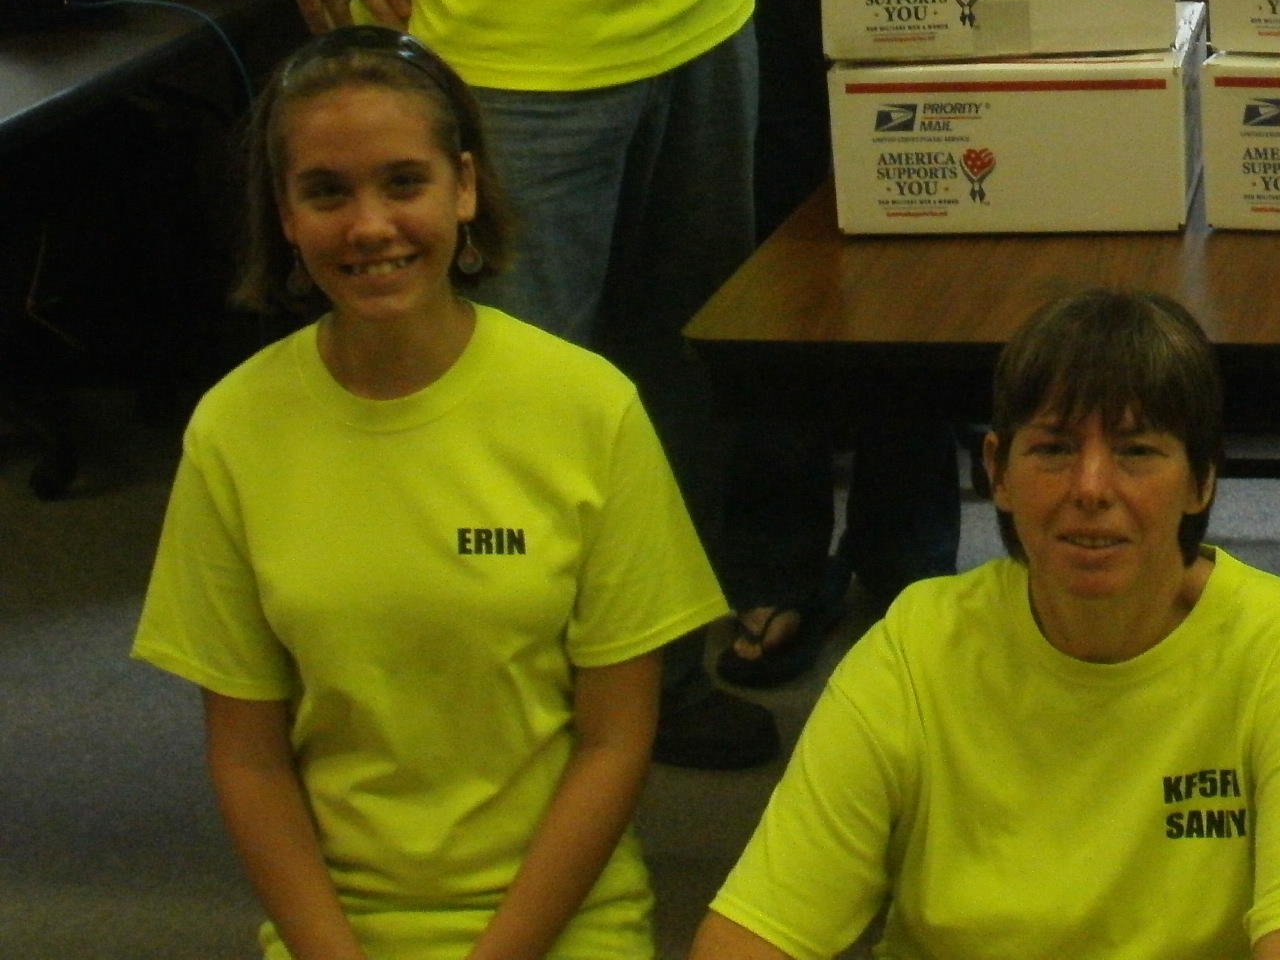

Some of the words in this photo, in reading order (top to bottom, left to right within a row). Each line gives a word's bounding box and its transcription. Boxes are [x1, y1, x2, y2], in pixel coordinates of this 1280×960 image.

[884, 6, 928, 22] YOU
[922, 102, 982, 114] PRIORITY
[920, 121, 953, 132] MAIL
[878, 152, 956, 166] AMERICA
[876, 166, 958, 180] SUPPORTS
[895, 181, 938, 196] YOU
[457, 528, 526, 555] ERIN
